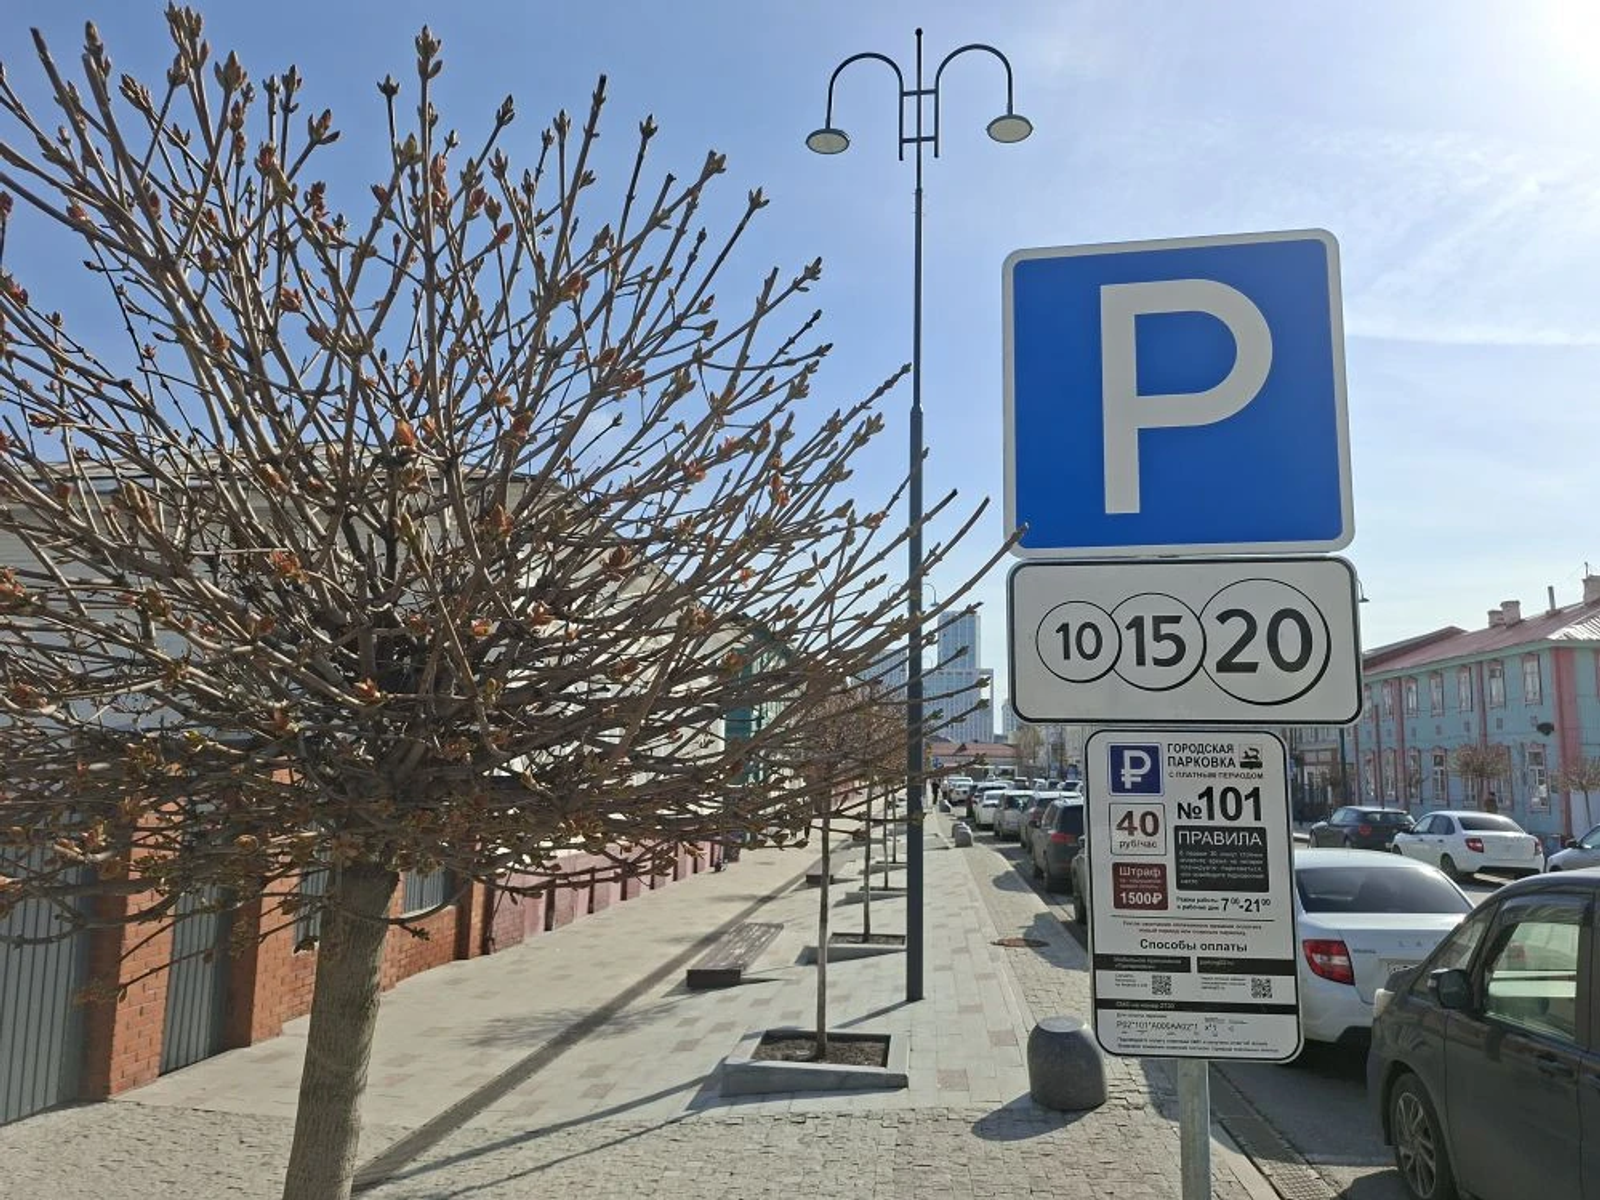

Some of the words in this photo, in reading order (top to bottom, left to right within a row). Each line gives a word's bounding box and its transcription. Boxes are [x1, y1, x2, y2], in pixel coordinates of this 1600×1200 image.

[1100, 279, 1273, 514] P
[1055, 621, 1103, 661] 10
[1125, 615, 1187, 667] 15
[1215, 608, 1313, 673] 20
[1167, 743, 1235, 755] ГОРОДСКАЯ
[1167, 756, 1236, 768] ПАРКОВКА
[1175, 771, 1217, 779] ПЛАТНЫМ
[1218, 772, 1264, 780] ПЕРИОДОМ
[1116, 810, 1160, 837] 40
[1119, 839, 1158, 849] руб/час
[1178, 831, 1263, 846] ПРАВИЛА
[1119, 866, 1161, 878] Штраф
[1140, 939, 1196, 950] Способы
[1200, 941, 1248, 952] оплаты
